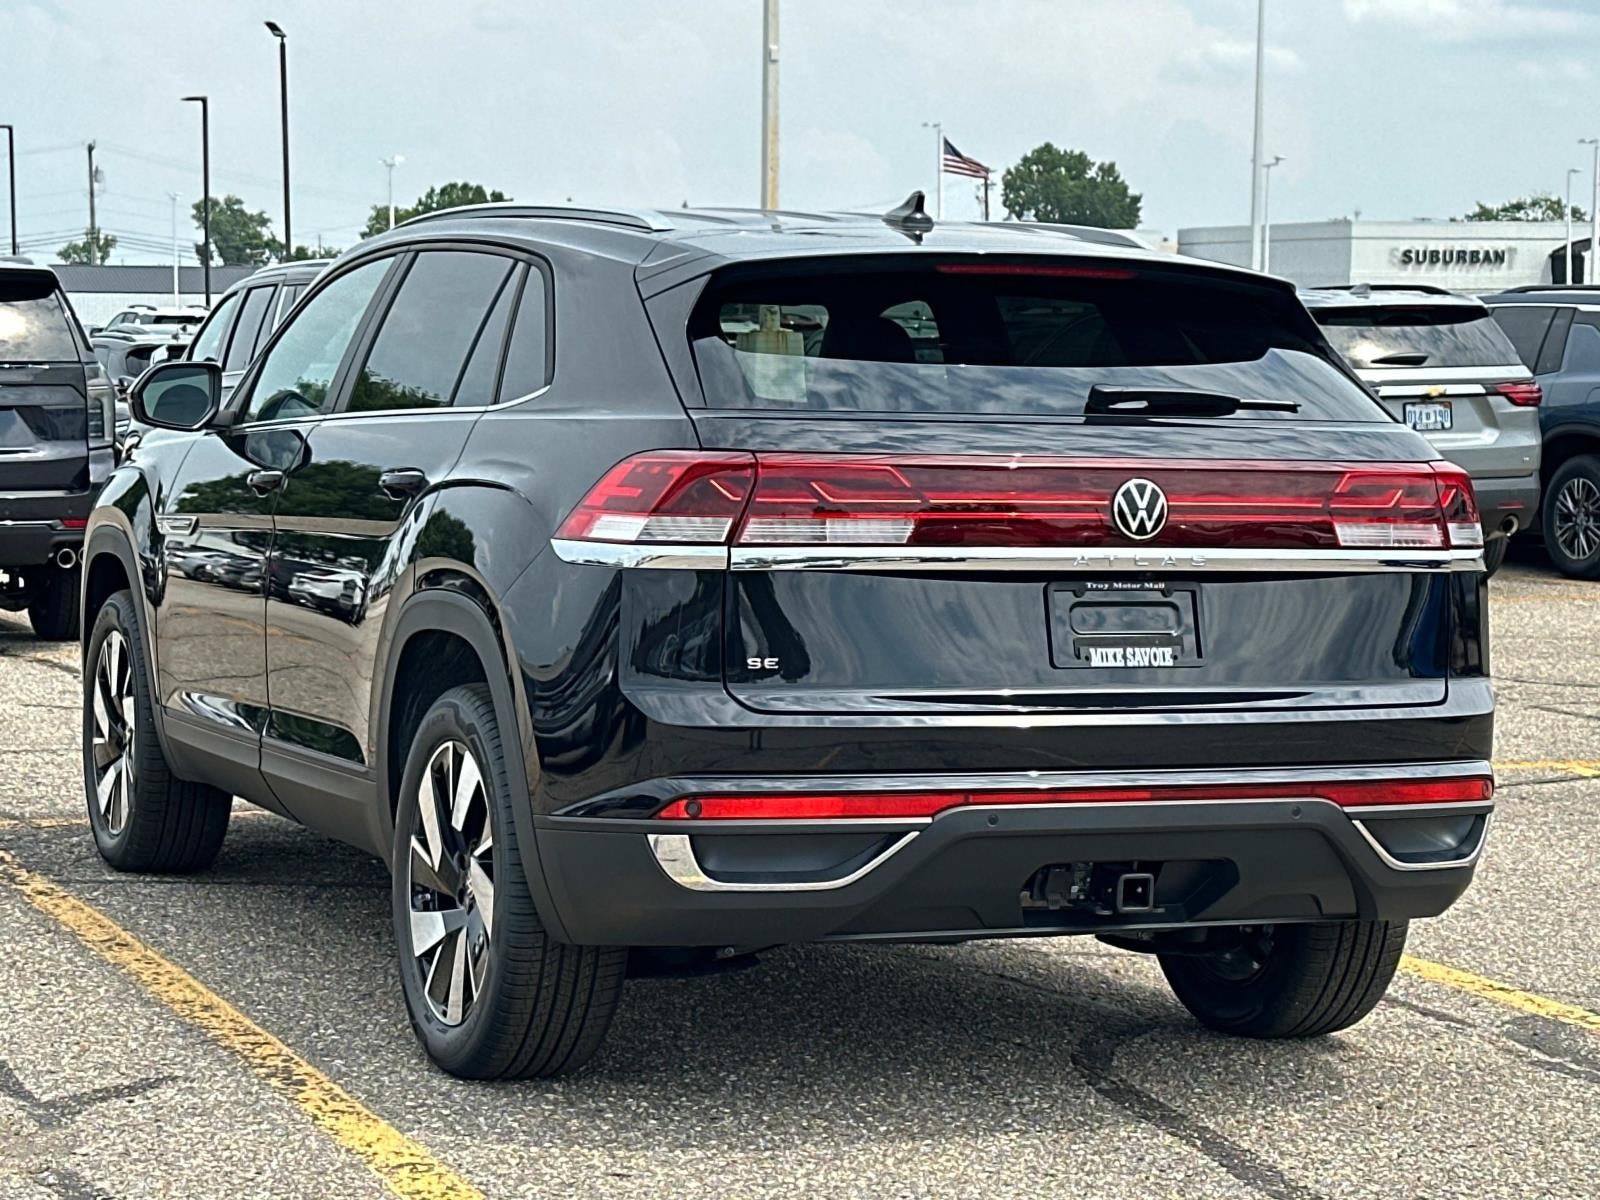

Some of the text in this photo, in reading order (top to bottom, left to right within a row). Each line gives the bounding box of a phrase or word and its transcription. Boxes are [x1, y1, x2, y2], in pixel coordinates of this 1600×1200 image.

[1401, 248, 1505, 265] SUBURBAN
[1073, 554, 1207, 566] ATLAS
[1085, 582, 1109, 590] Troy
[747, 657, 779, 669] SE
[1089, 647, 1174, 667] MIKE SAVOIE
